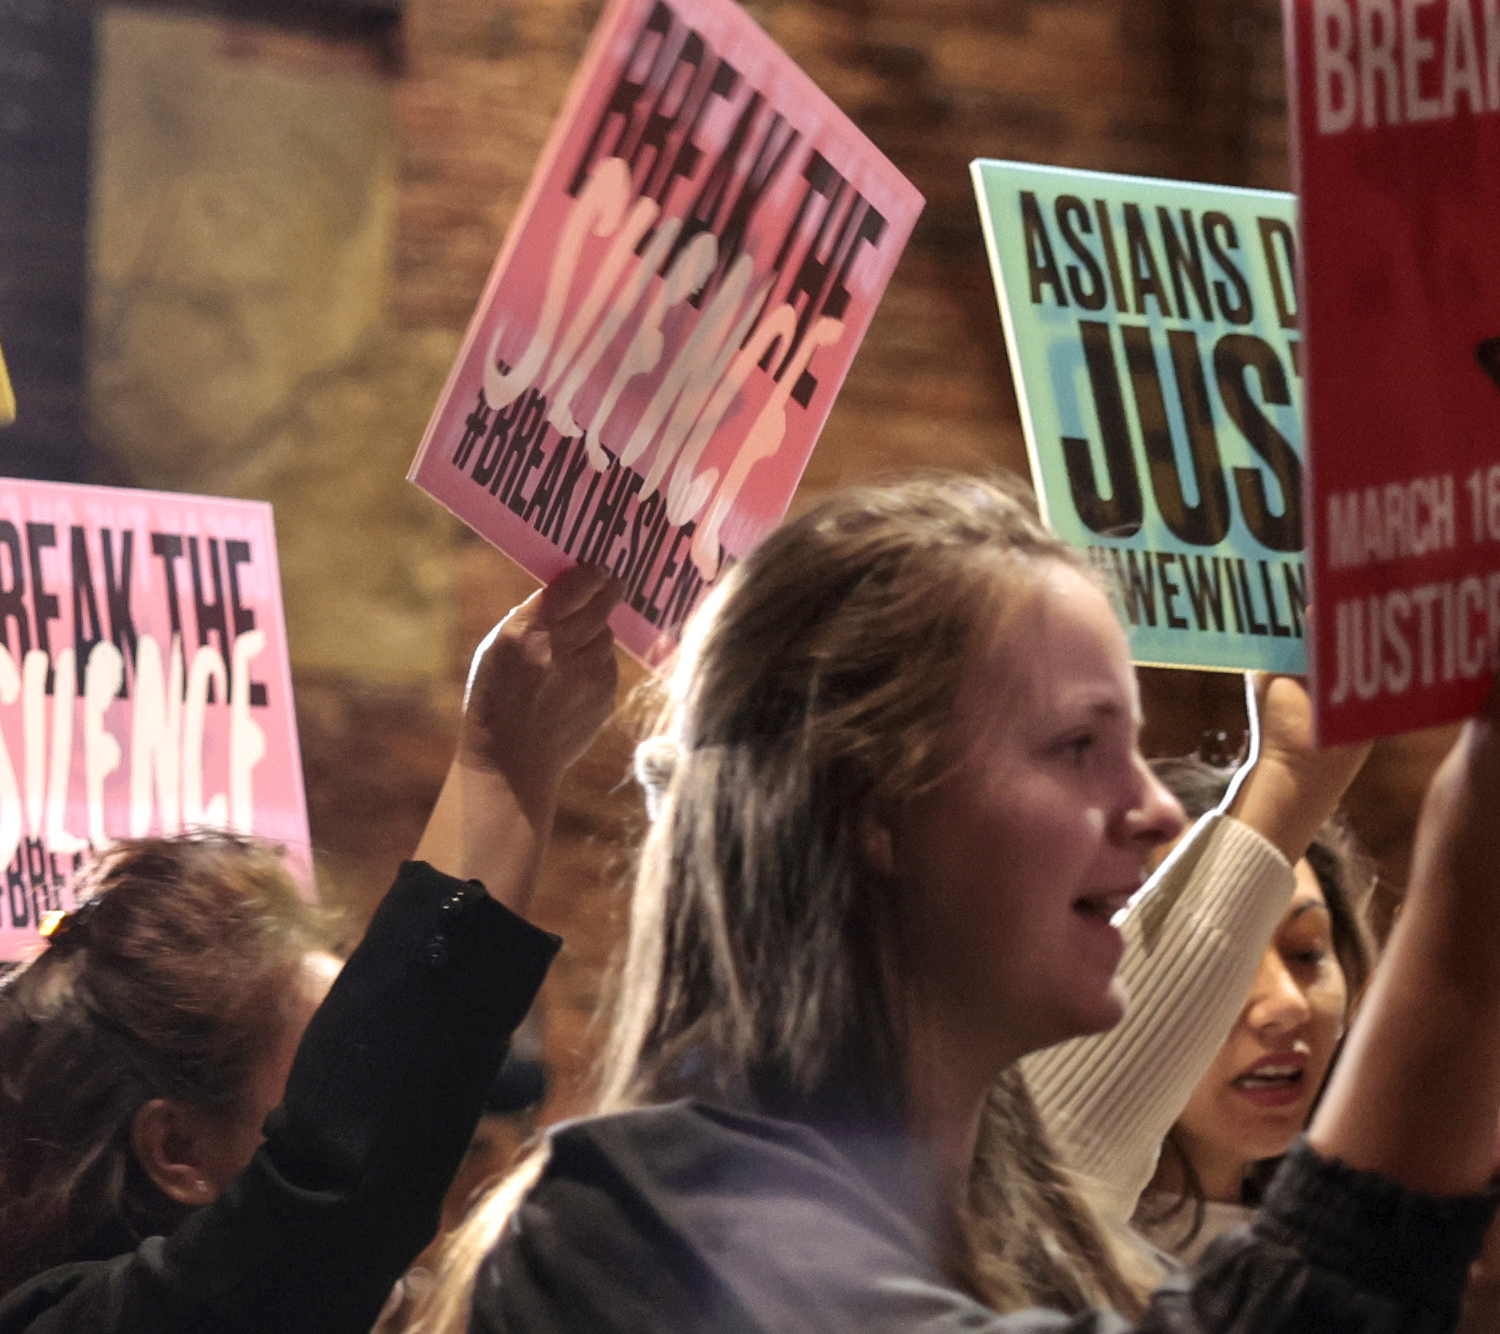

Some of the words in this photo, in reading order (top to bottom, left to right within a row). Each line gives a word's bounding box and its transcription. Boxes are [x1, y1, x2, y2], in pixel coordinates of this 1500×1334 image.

[738, 147, 891, 410] THE
[1018, 189, 1254, 325] ASIANS
[484, 156, 846, 582] SILENCE
[1060, 321, 1304, 554] JUS
[151, 531, 268, 708] THE
[1327, 474, 1456, 571] MARCH
